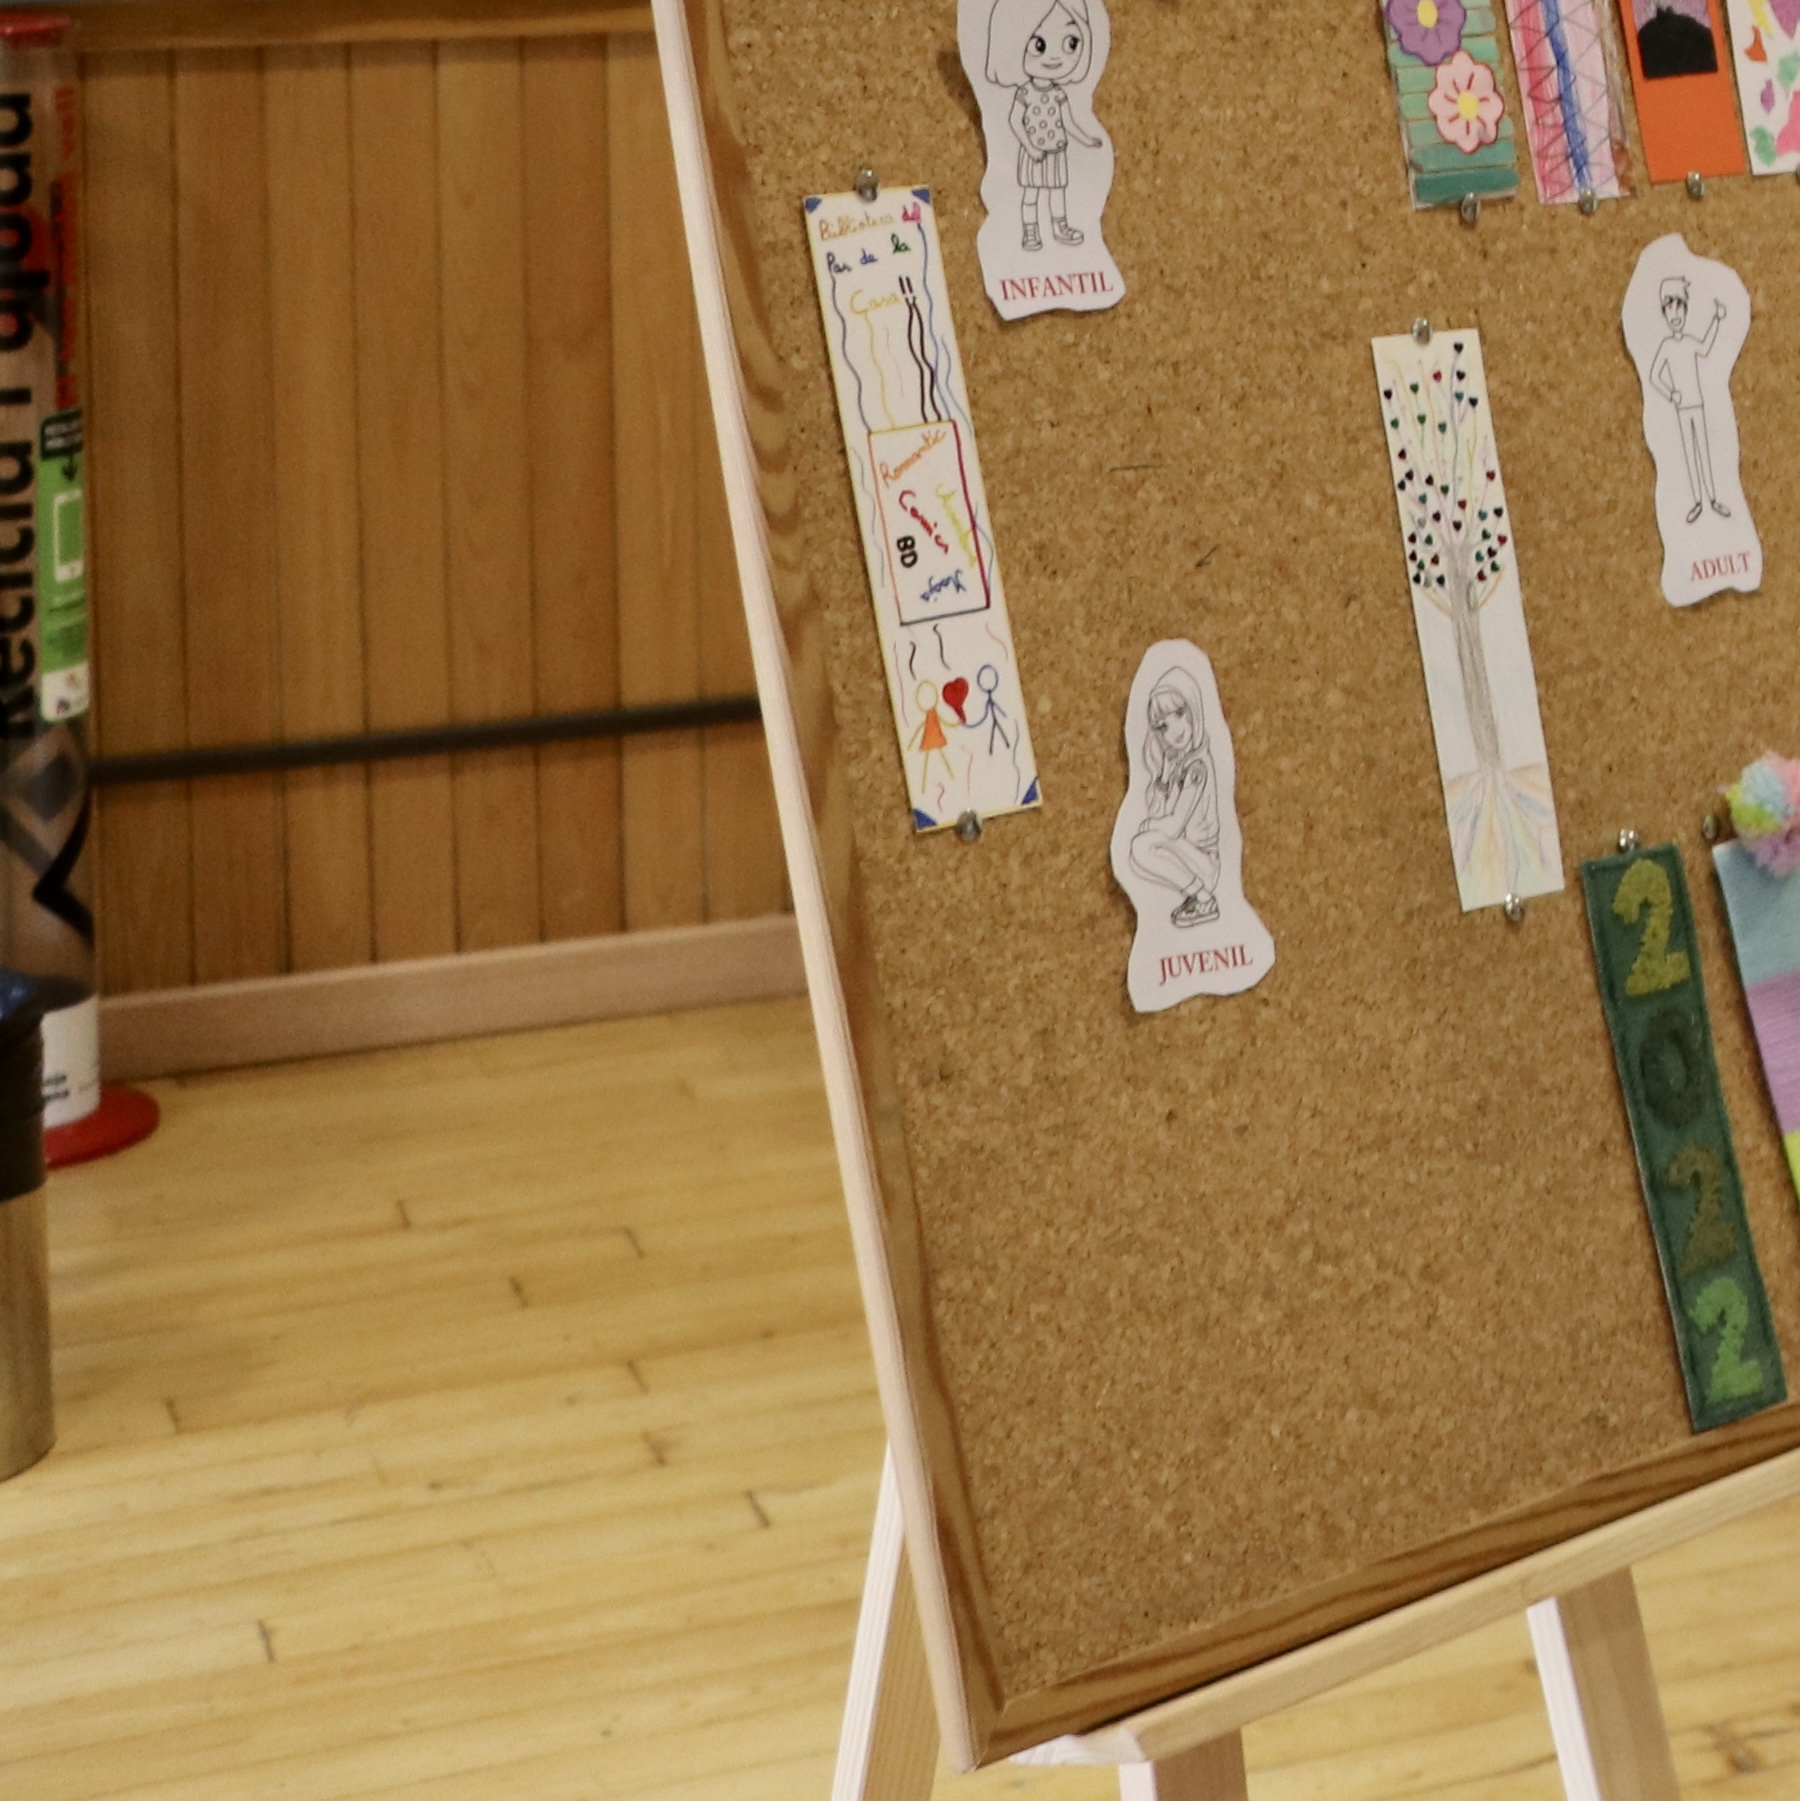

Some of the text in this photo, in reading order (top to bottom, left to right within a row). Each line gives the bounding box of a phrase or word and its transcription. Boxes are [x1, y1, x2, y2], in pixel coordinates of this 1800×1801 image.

[1000, 271, 1114, 301] INFANTIL
[896, 535, 918, 568] BD
[1690, 551, 1751, 582] ADULT
[1158, 944, 1254, 986] JUVENIL
